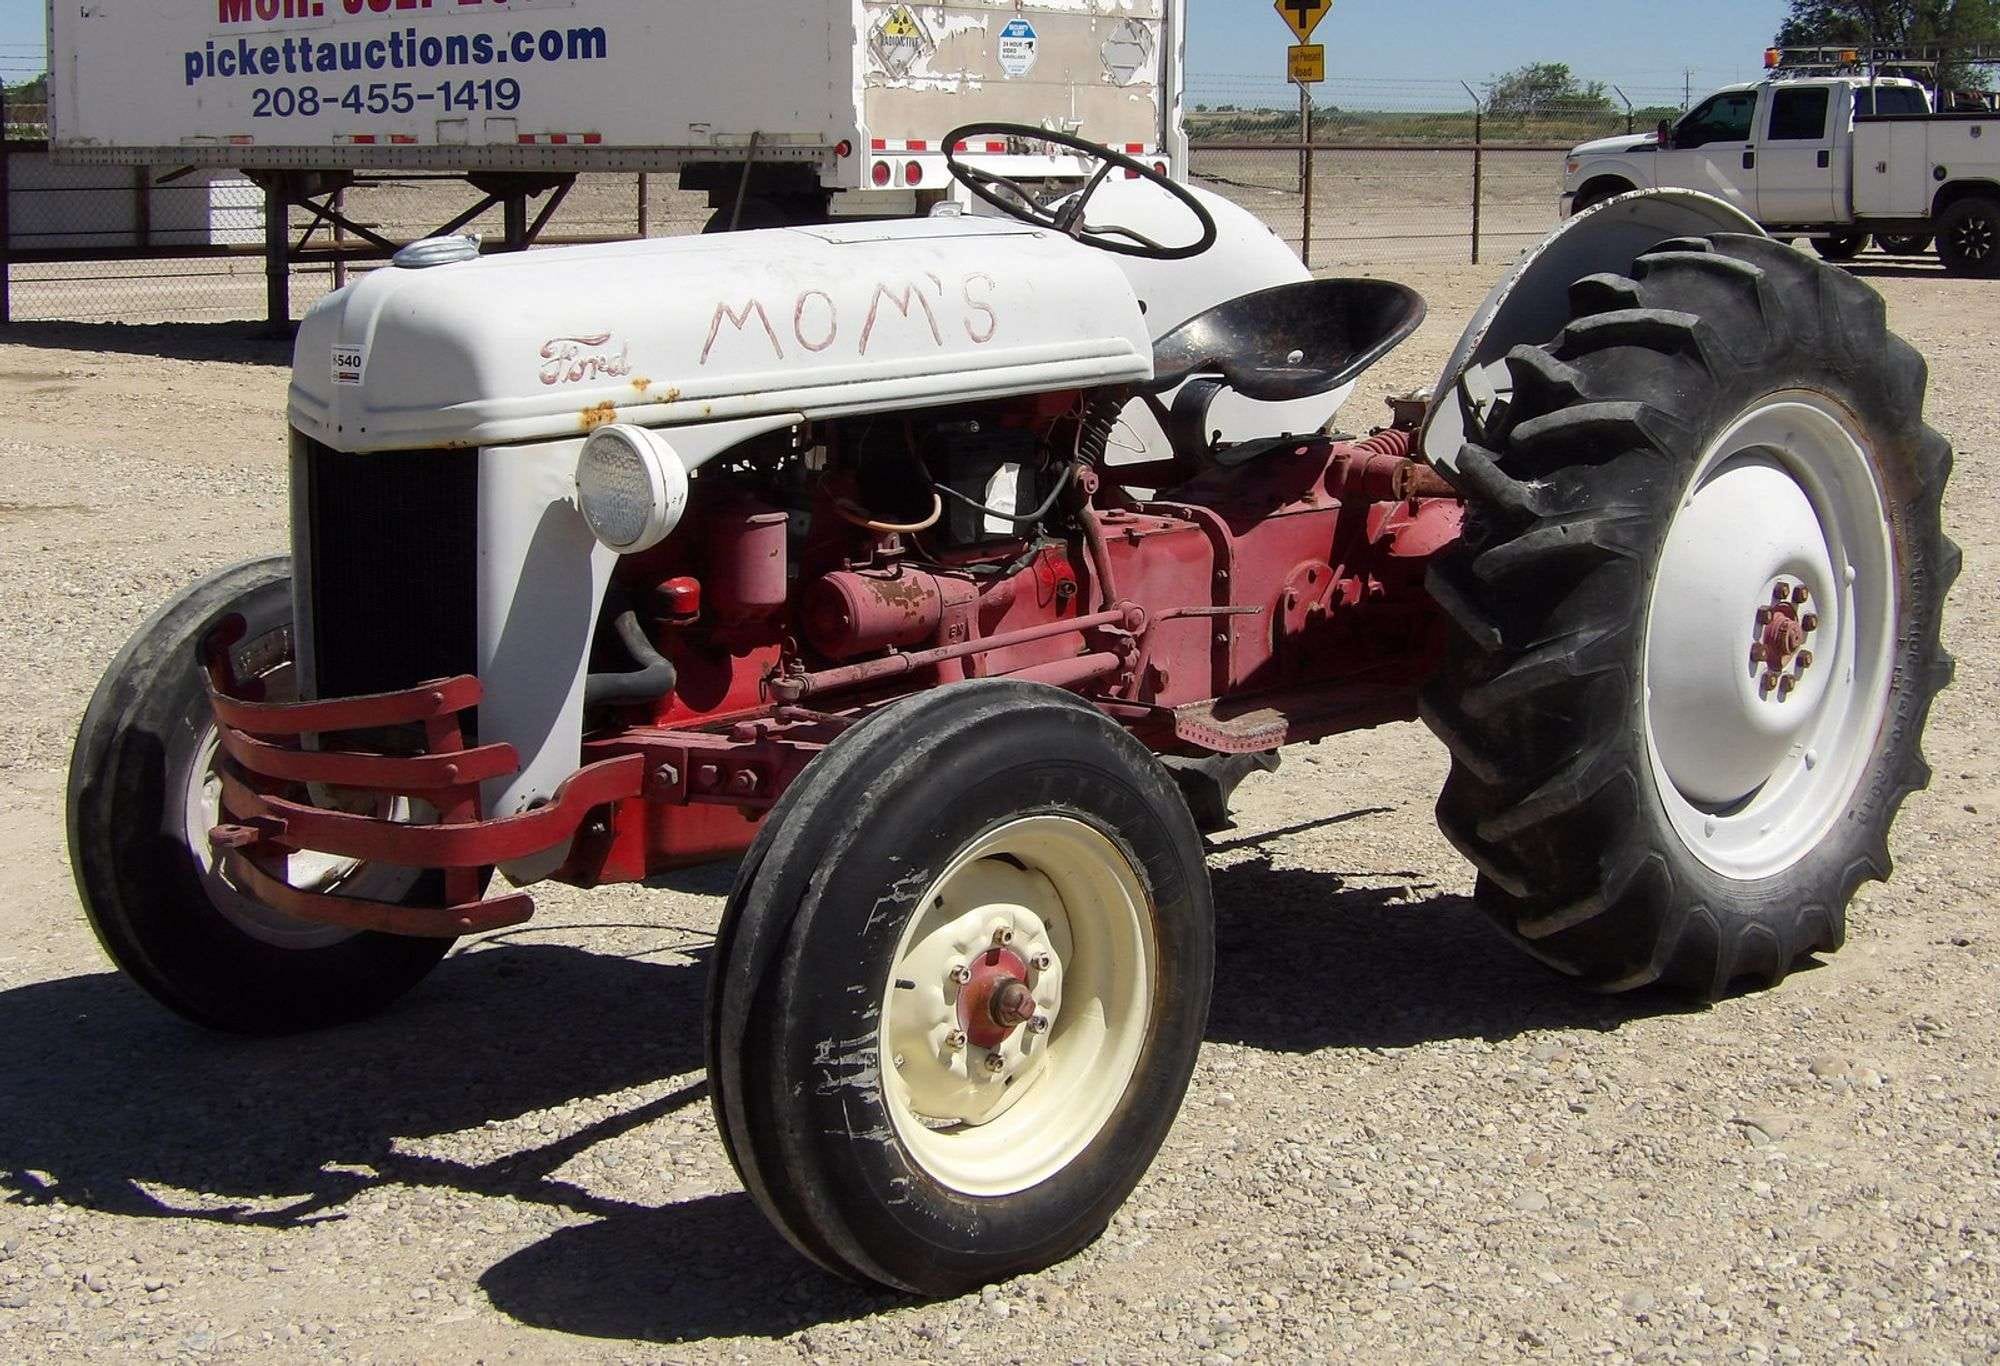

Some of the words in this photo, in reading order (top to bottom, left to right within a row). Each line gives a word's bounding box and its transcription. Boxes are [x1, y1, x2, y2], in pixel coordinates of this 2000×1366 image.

[185, 27, 606, 86] pickettauctions.com
[252, 78, 520, 117] 208-455-1419
[700, 272, 996, 365] MOM'S
[337, 354, 361, 368] 540
[539, 333, 632, 385] Ford
